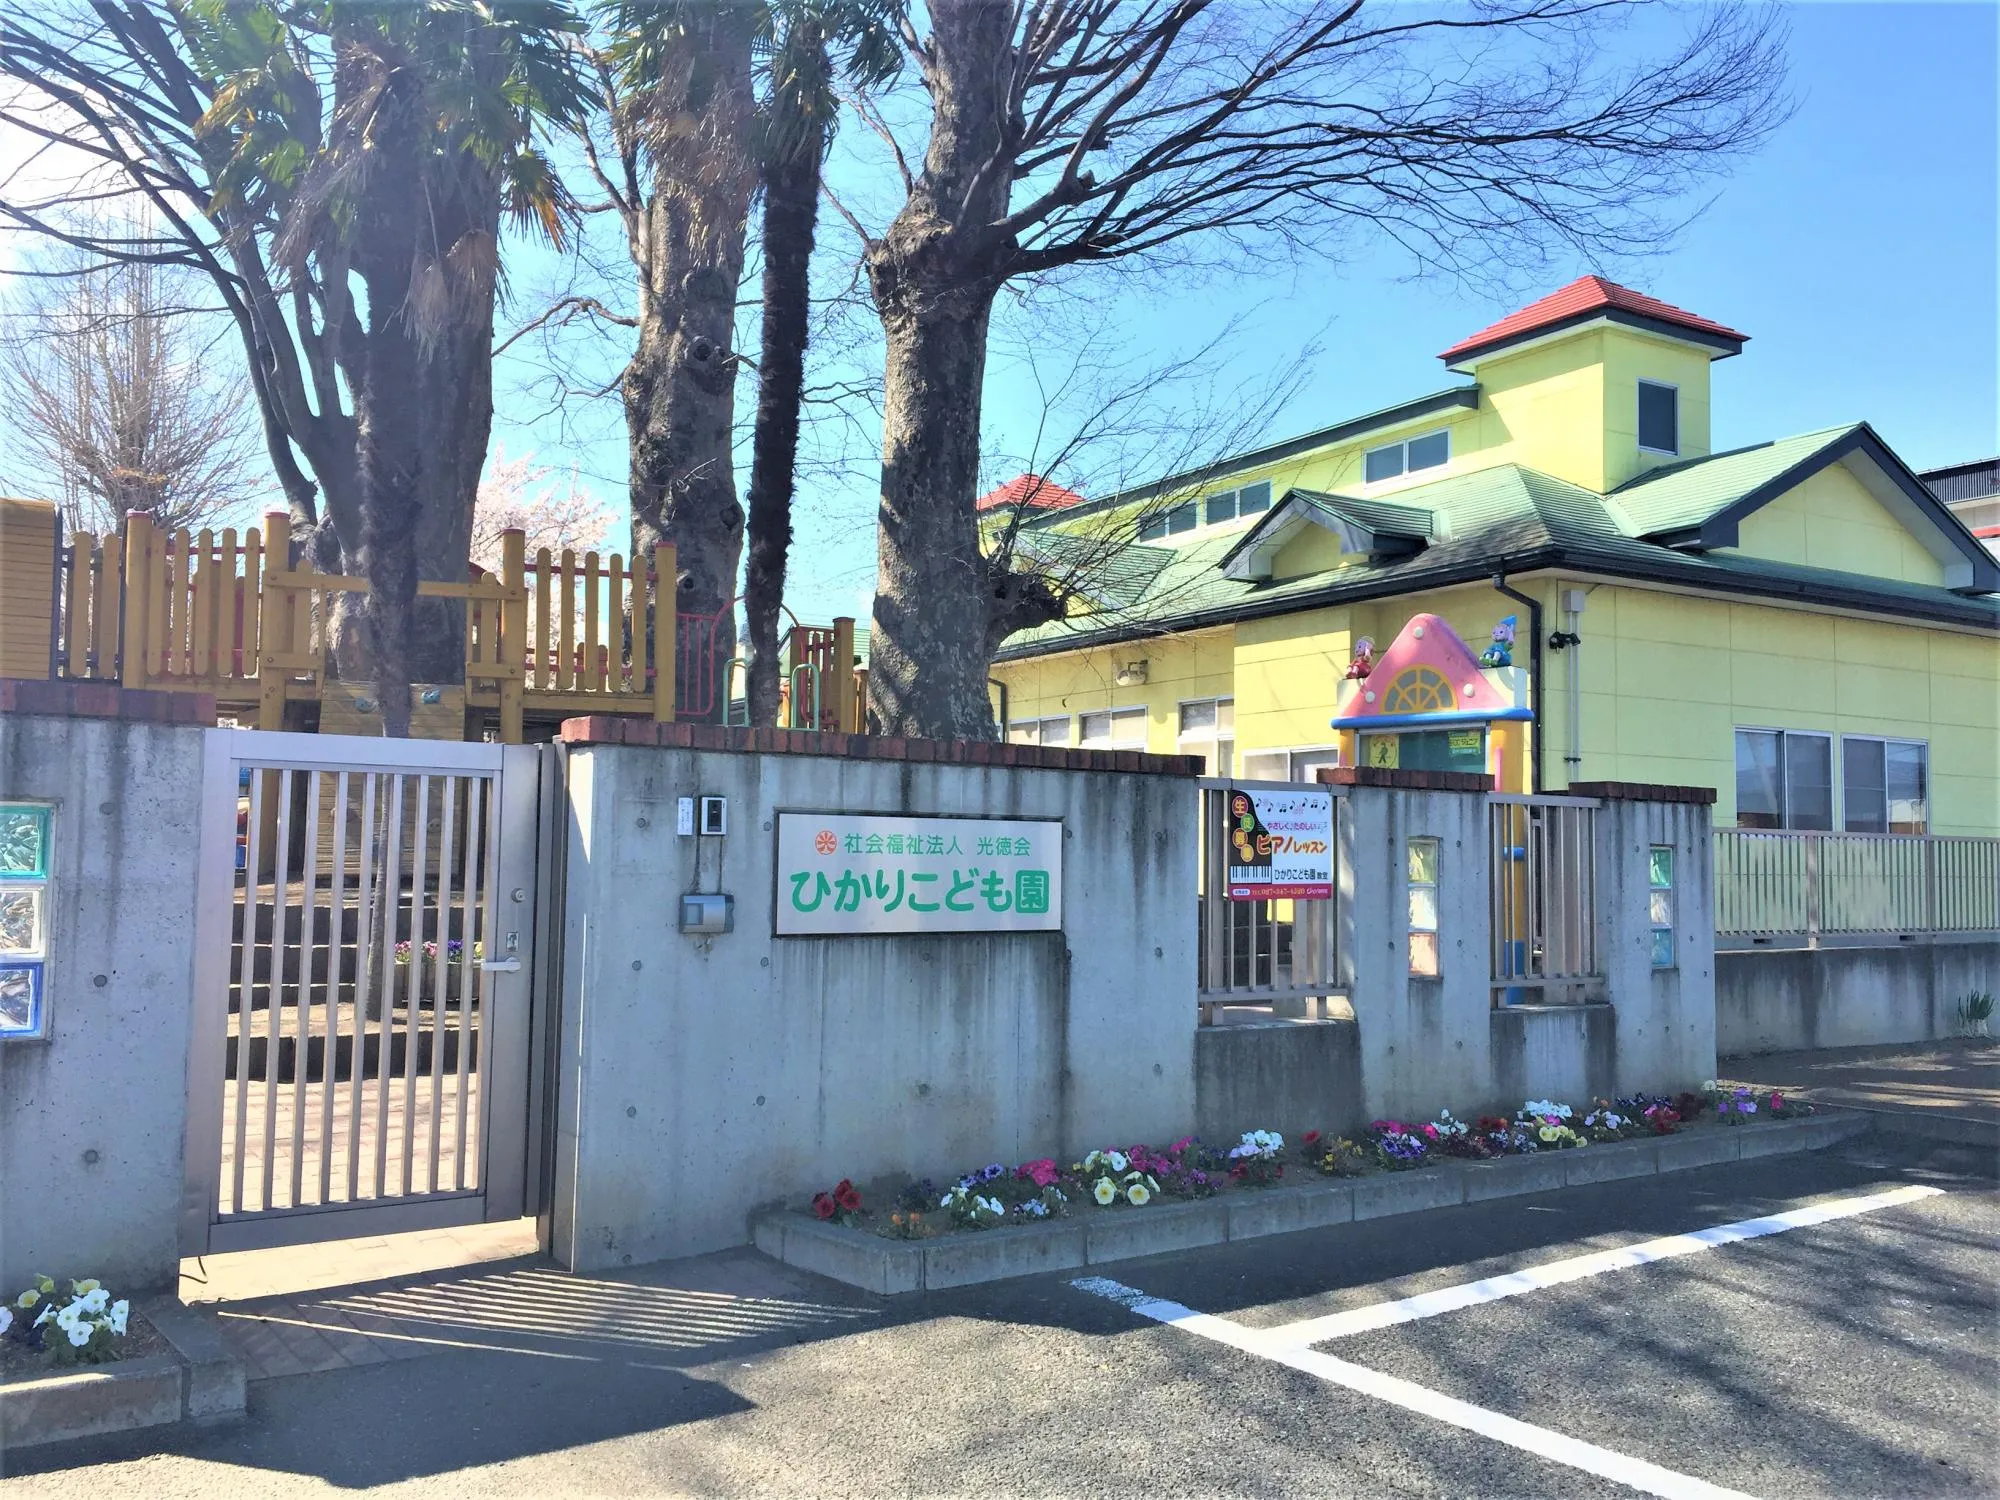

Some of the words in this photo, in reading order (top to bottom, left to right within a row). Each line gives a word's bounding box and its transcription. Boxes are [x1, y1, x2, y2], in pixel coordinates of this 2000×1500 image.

[844, 833, 963, 856] 社会福祉法人
[977, 836, 1032, 857] 光徳会
[1257, 834, 1328, 855] ピアノレッスン
[790, 867, 1050, 914] ひかりこども園
